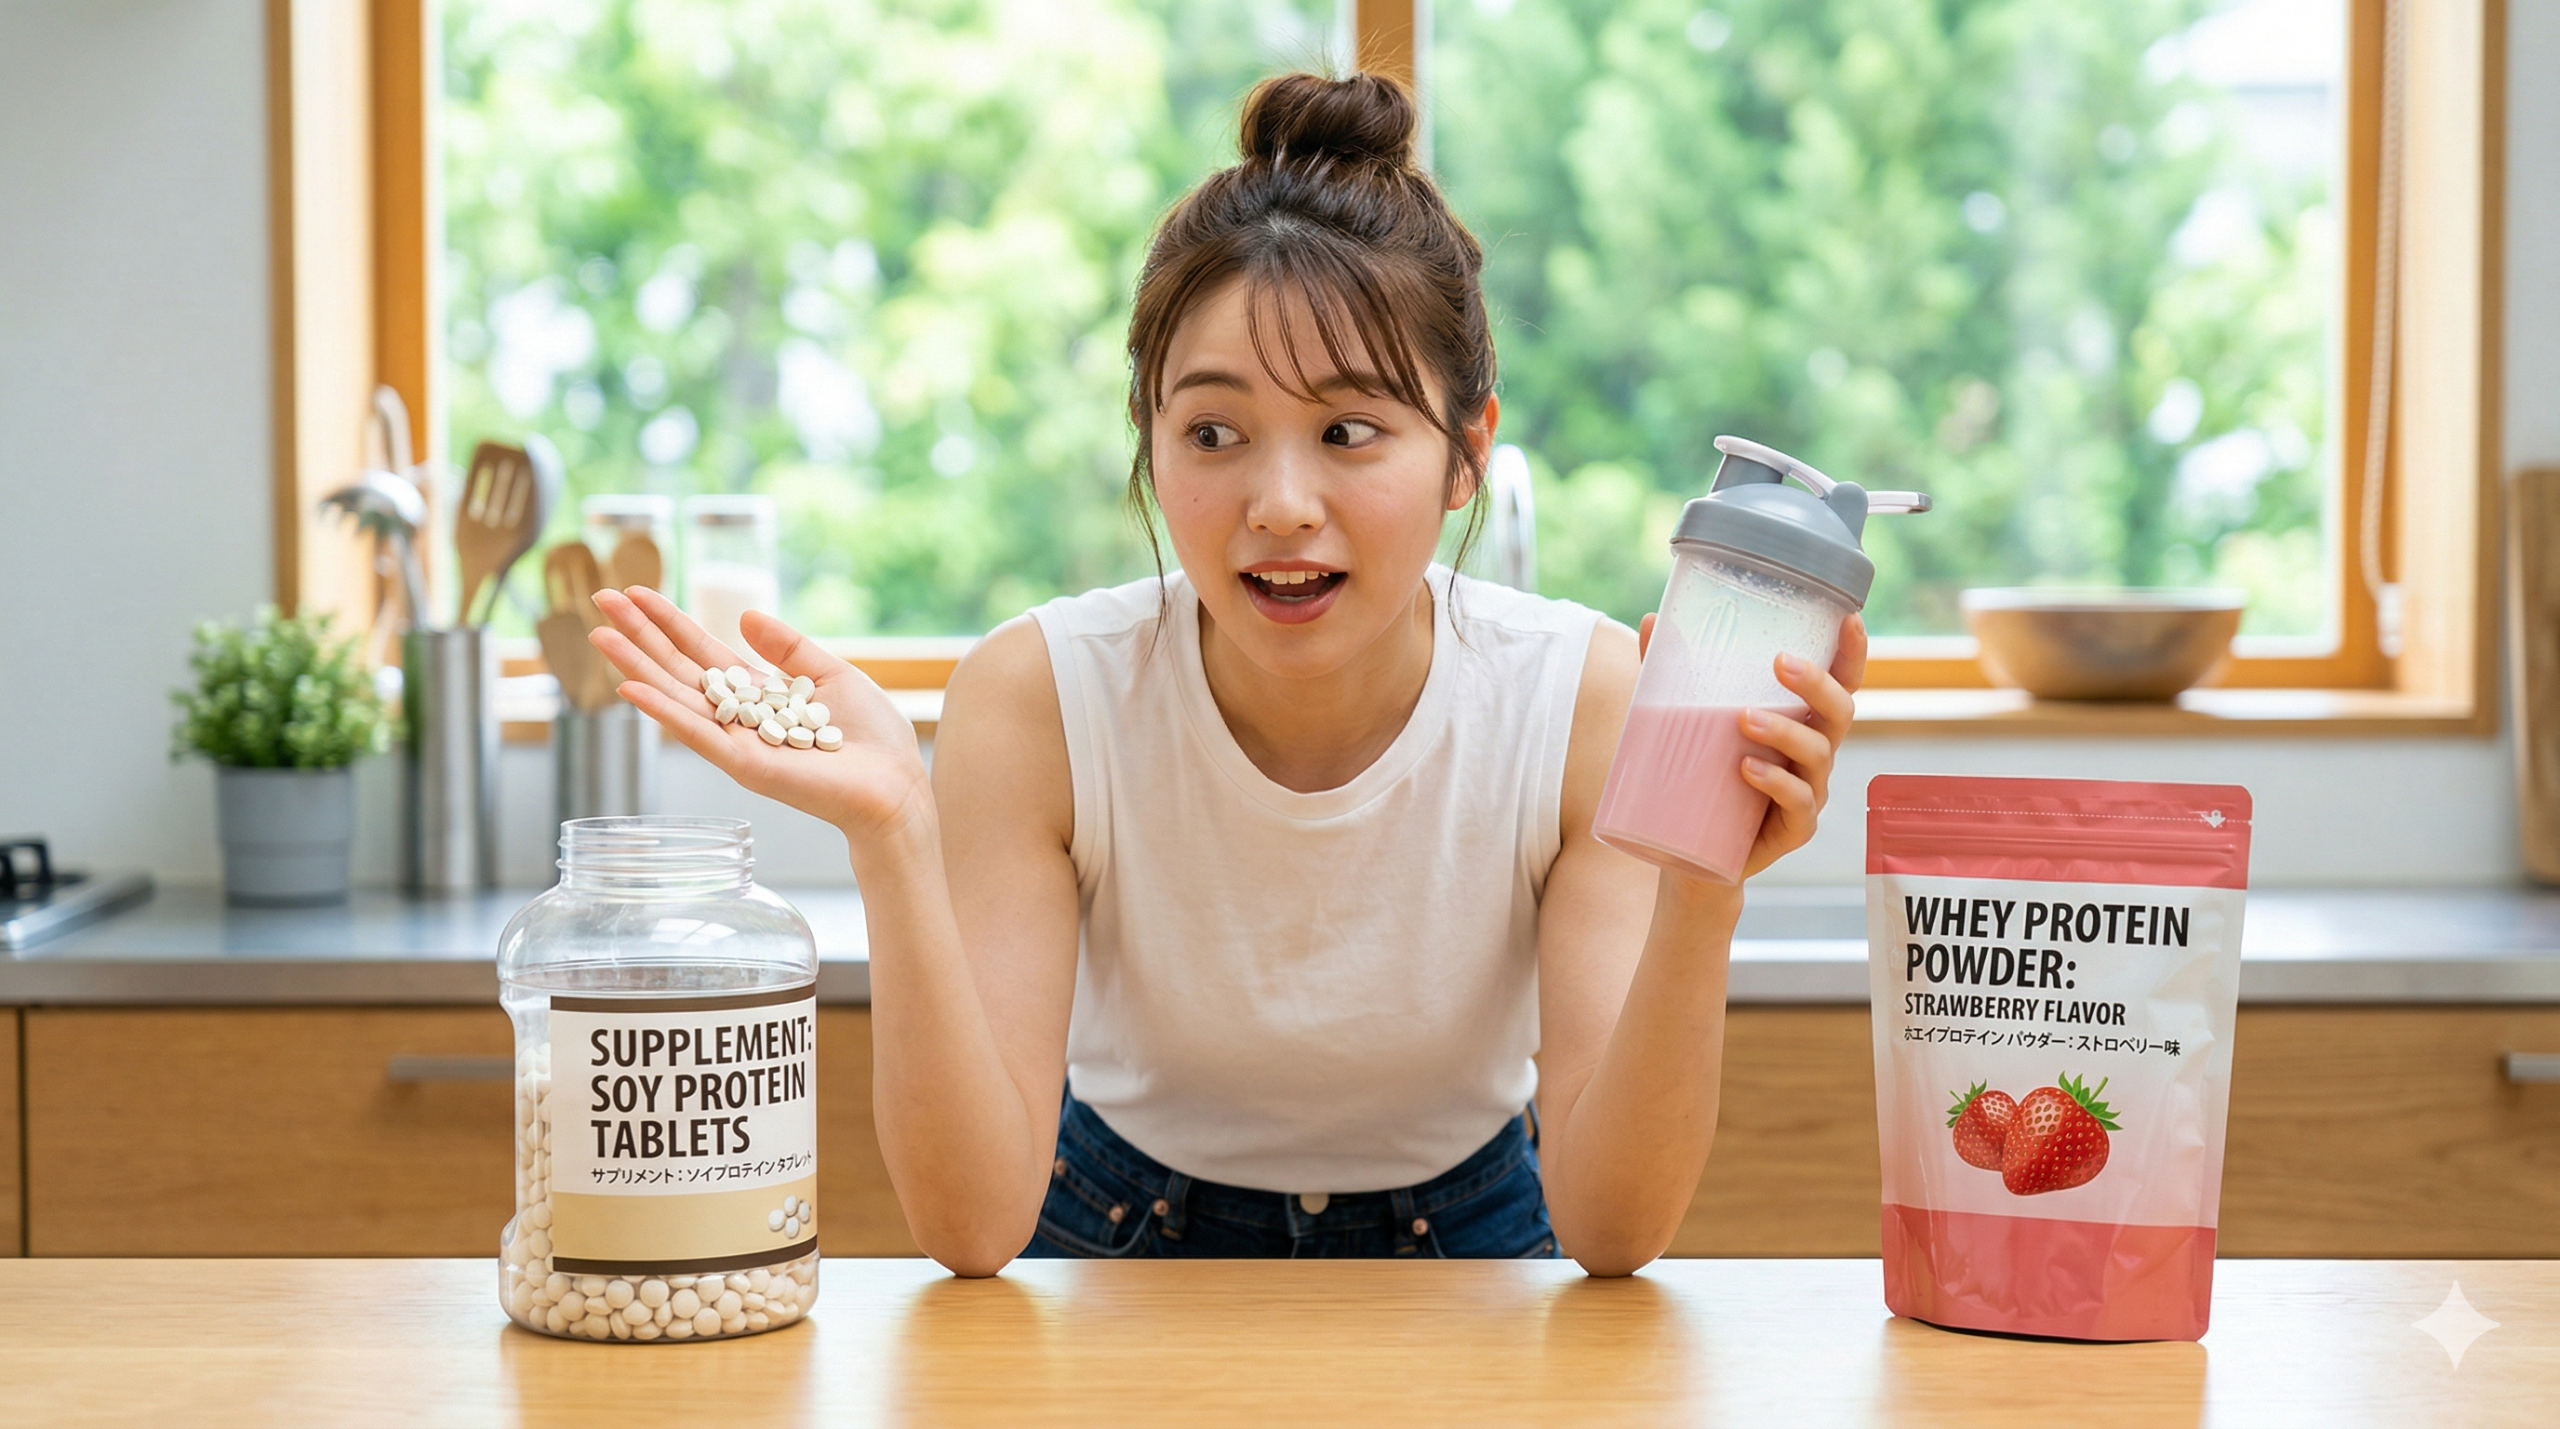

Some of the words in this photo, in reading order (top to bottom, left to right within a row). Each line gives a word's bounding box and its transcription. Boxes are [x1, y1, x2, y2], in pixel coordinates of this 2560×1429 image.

[1904, 895, 2017, 940] WHEY
[2023, 901, 2190, 947] PROTEIN
[1905, 943, 2077, 990] POWDER:
[1904, 992, 2040, 1022] STRAWBERRY
[2043, 999, 2126, 1026] FLAVOR
[590, 1016, 812, 1067] SUPPLEMENT:
[591, 1075, 663, 1113] SOY
[675, 1061, 806, 1112] PROTEIN
[590, 1115, 750, 1159] TABLETS
